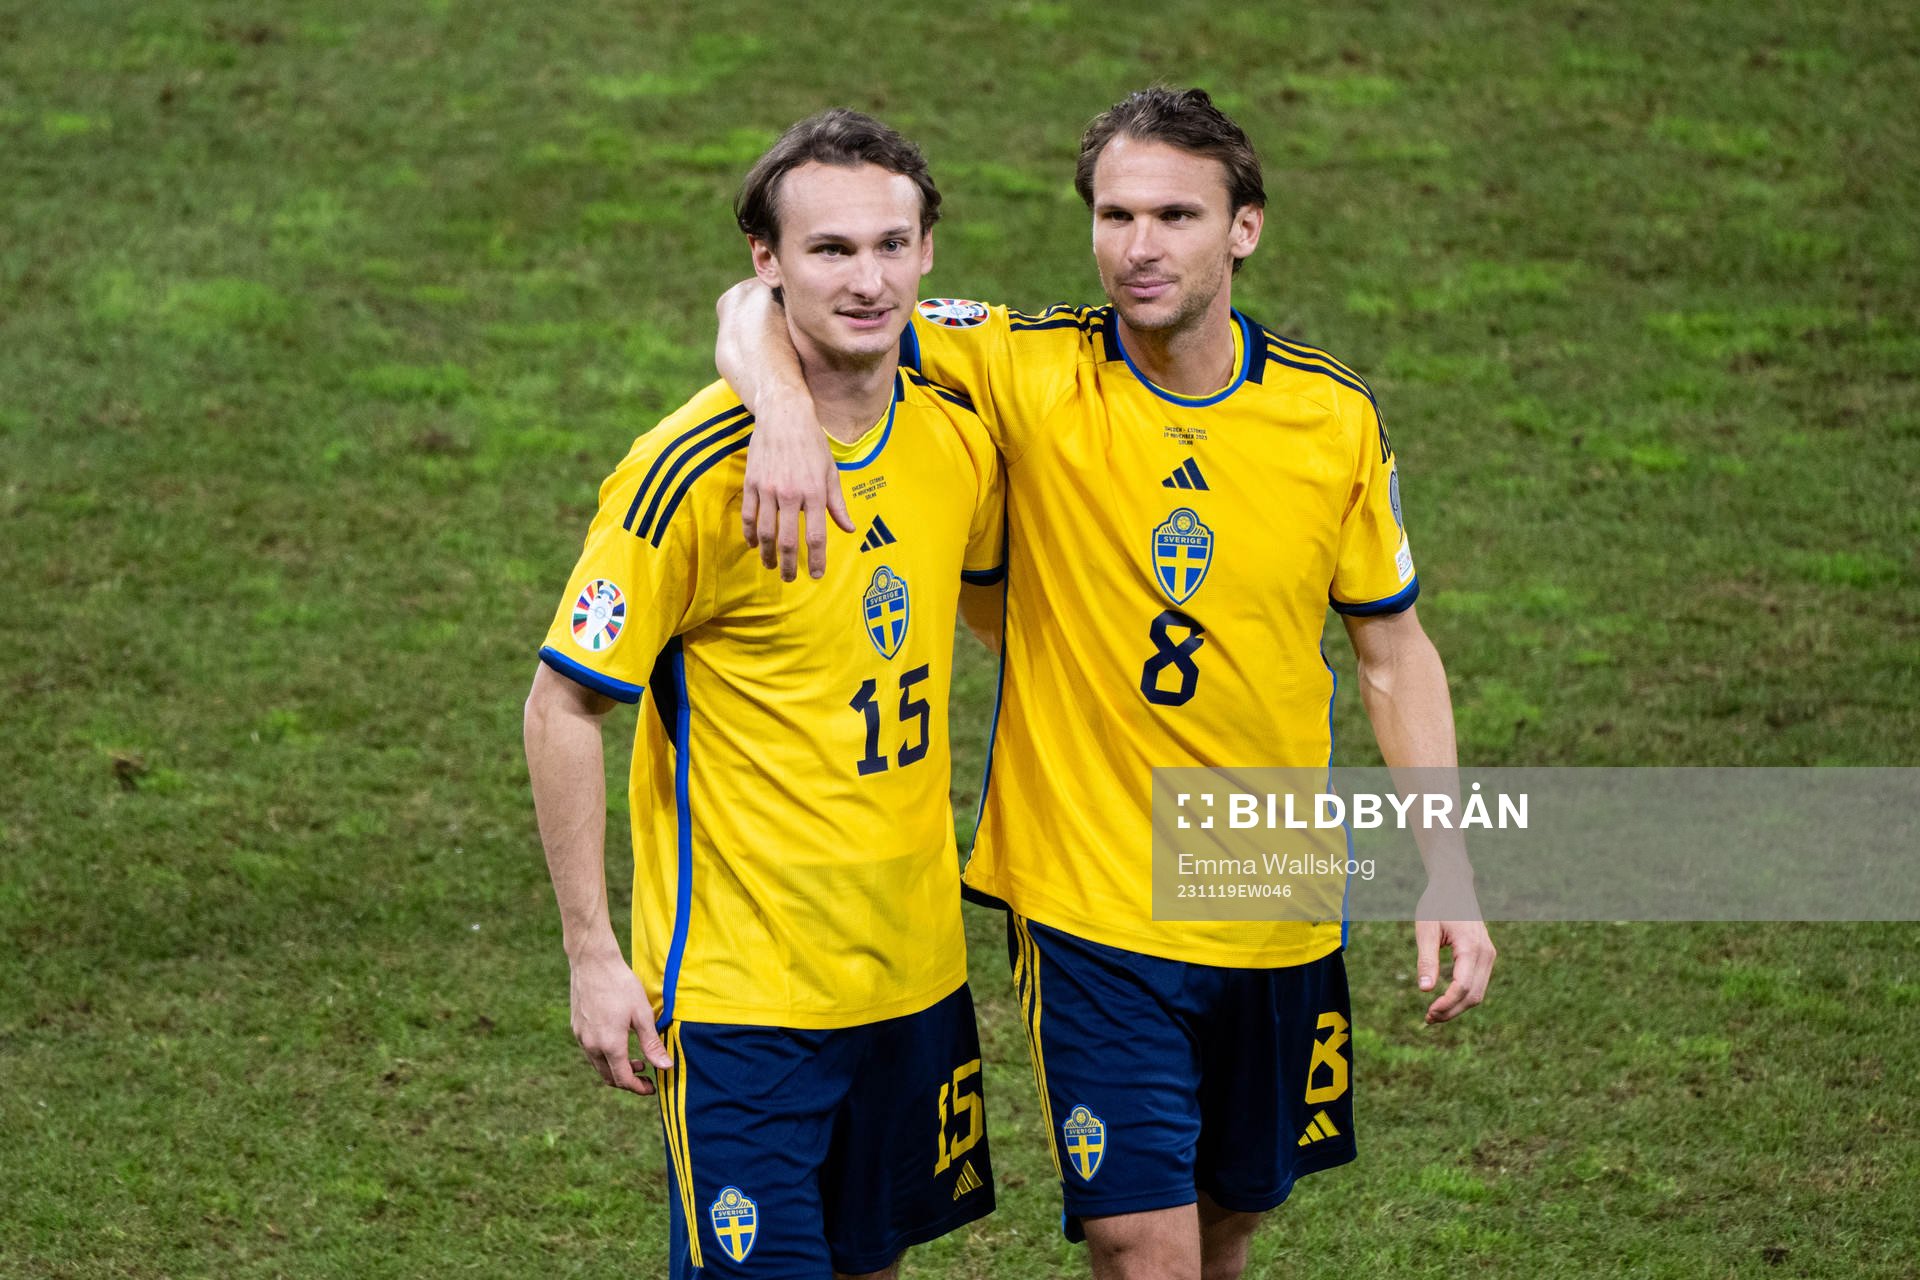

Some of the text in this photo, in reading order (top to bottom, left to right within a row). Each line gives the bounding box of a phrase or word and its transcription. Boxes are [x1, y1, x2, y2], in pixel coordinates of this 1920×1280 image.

[1163, 535, 1202, 545] SVERIGE
[870, 590, 899, 606] SVERIGE
[1140, 609, 1205, 707] 8
[849, 663, 930, 776] 15
[1305, 1011, 1350, 1105] 8
[933, 1058, 984, 1178] 15
[1069, 1127, 1097, 1135] SVERIGE
